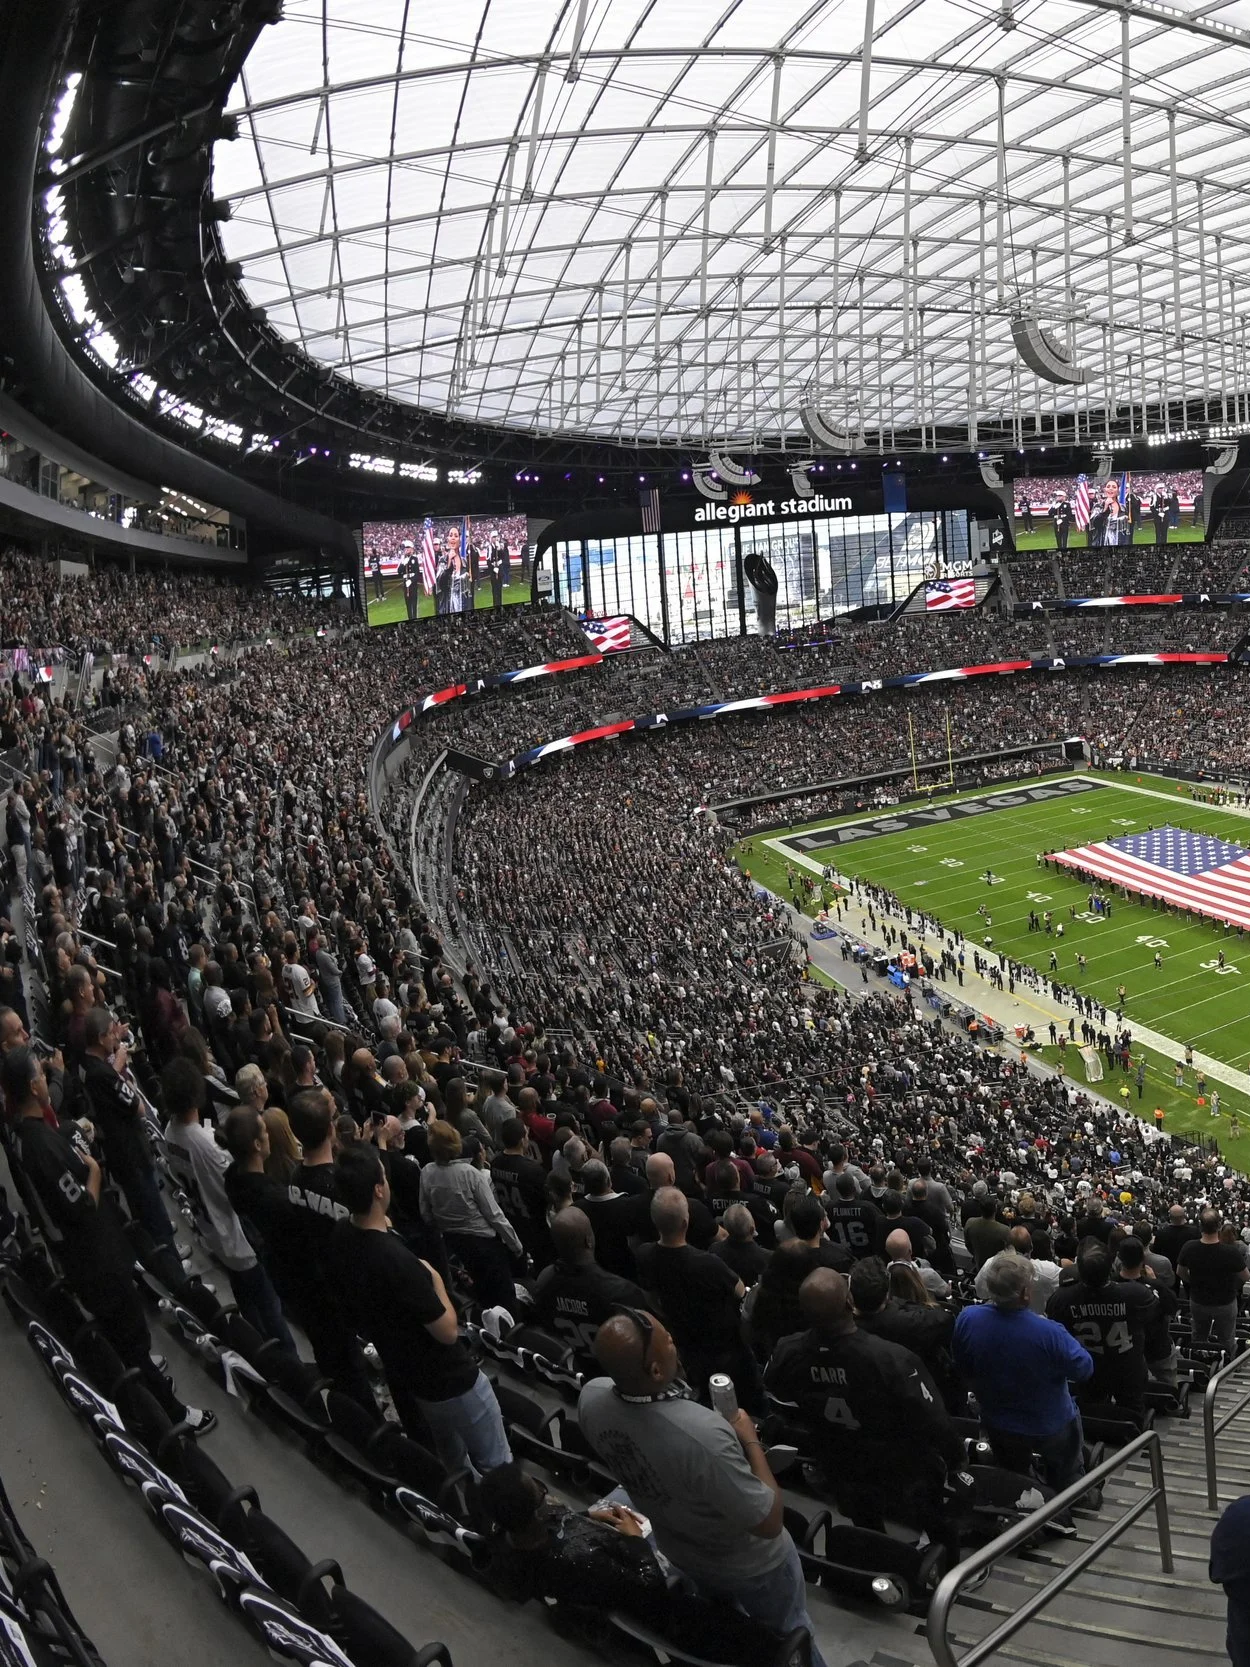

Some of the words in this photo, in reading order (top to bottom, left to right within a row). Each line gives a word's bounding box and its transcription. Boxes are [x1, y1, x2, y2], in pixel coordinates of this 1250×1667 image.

[694, 501, 775, 523] allegiant
[781, 495, 852, 515] stadium
[942, 560, 973, 571] MGM
[796, 819, 909, 849] LAS
[911, 781, 1094, 821] VEGAS
[1074, 911, 1106, 924] 50
[1135, 935, 1168, 948] 40
[832, 1207, 862, 1217] PLUNKETT
[834, 1221, 869, 1247] 16
[556, 1296, 588, 1317] JACOBS
[1073, 1320, 1134, 1355] 24
[811, 1366, 847, 1386] CARR
[920, 1380, 934, 1402] 4
[824, 1397, 861, 1430] 4
